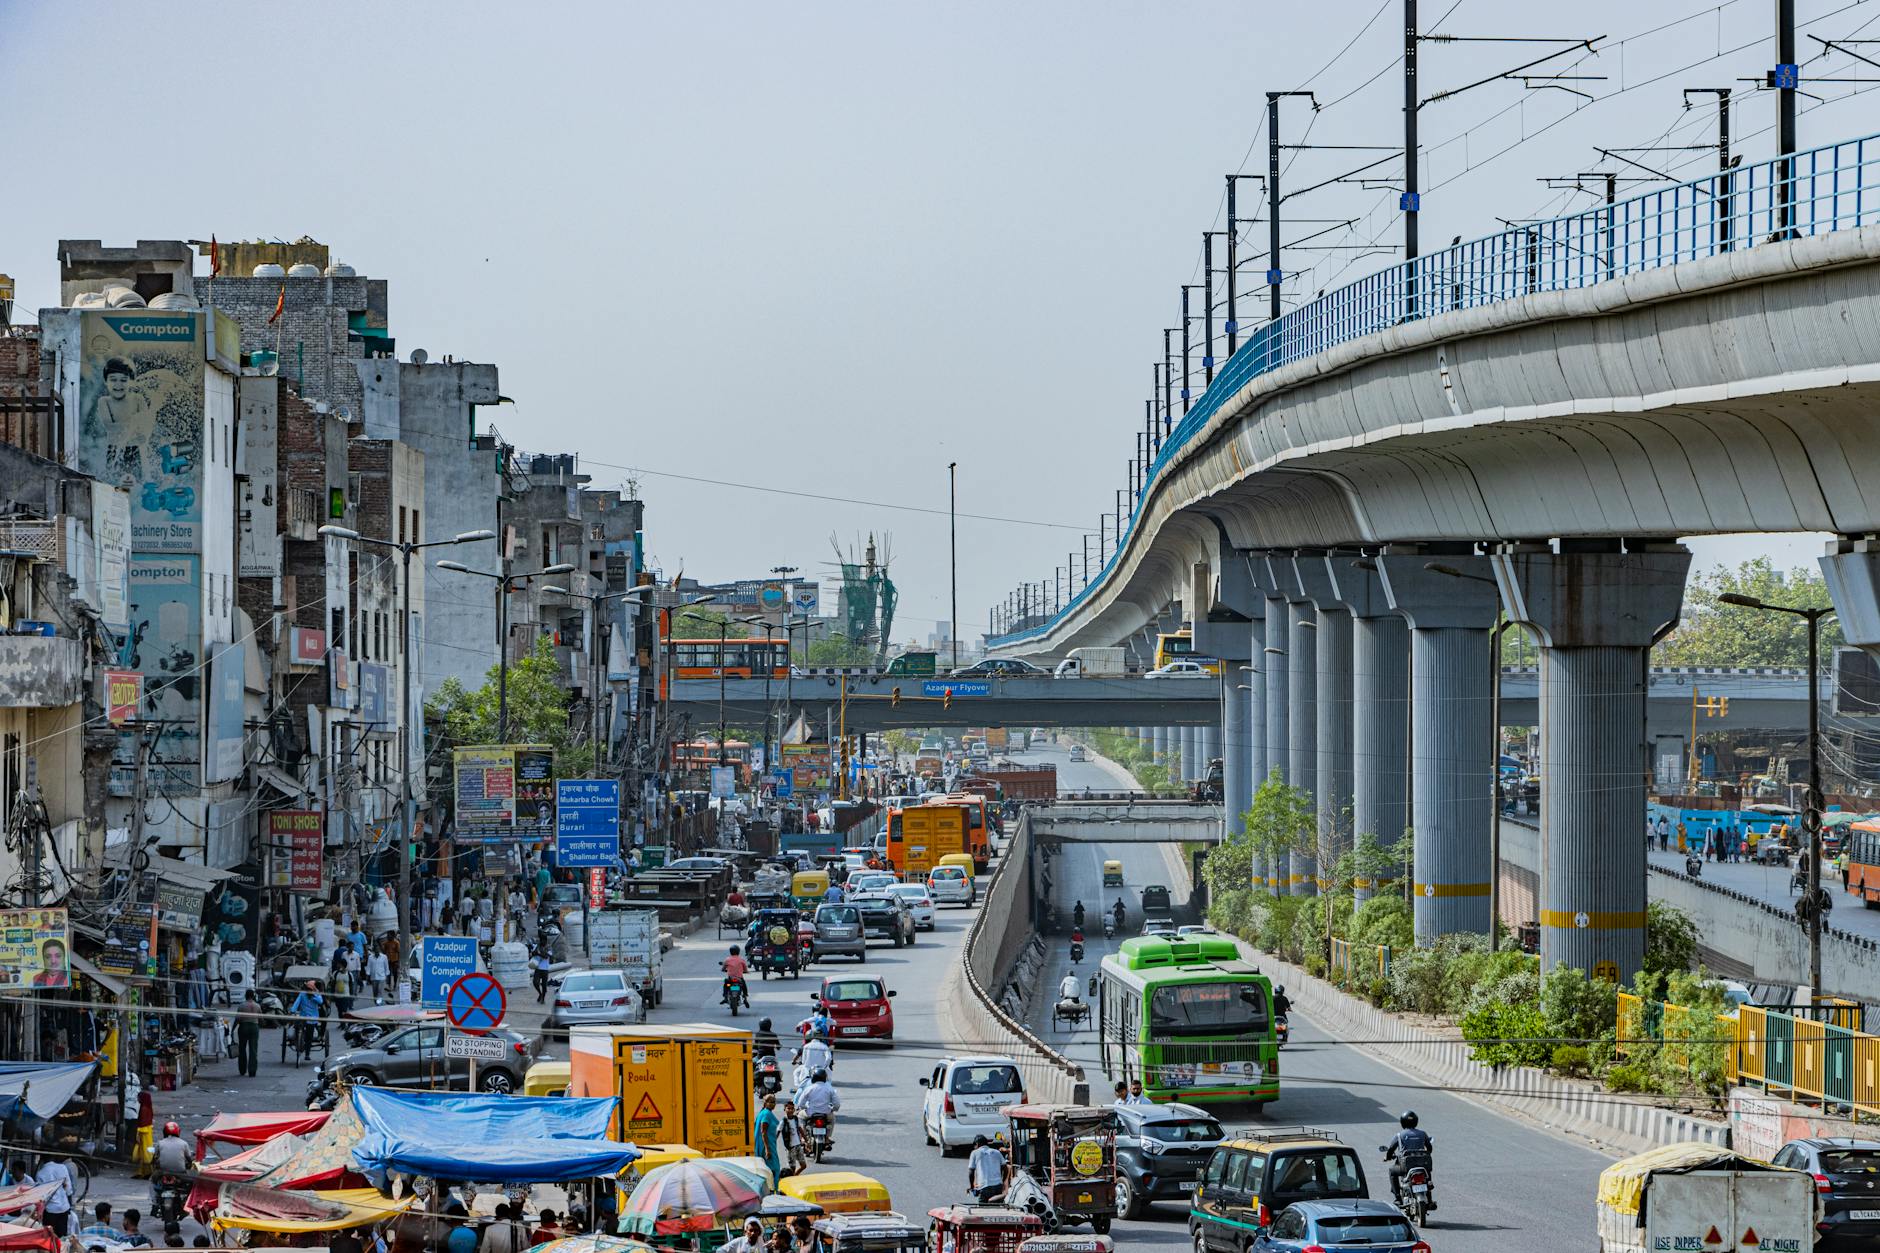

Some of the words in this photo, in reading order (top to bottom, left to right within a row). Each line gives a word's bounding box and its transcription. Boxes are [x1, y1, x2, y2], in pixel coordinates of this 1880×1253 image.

[1783, 66, 1790, 76] 6
[1780, 77, 1794, 88] 33
[120, 323, 190, 336] Crompton
[170, 524, 193, 537] Store
[131, 567, 185, 579] ompton
[959, 684, 989, 692] Flyover
[272, 815, 292, 829] TONI
[294, 815, 320, 830] SHOES
[569, 853, 598, 861] Shalimar
[434, 942, 468, 952] Azadpur
[426, 953, 473, 964] Commercial
[600, 955, 617, 963] HORN
[623, 954, 644, 963] PLEASE
[431, 966, 467, 977] Complex
[451, 1039, 463, 1047] NO
[464, 1040, 502, 1049] STOPPING
[451, 1047, 463, 1055] NO
[464, 1048, 502, 1057] STANDING
[1655, 1236, 1671, 1249] USE
[1674, 1236, 1702, 1250] DIPPER
[1759, 1237, 1770, 1250] AT
[1773, 1238, 1800, 1251] NIGHT
